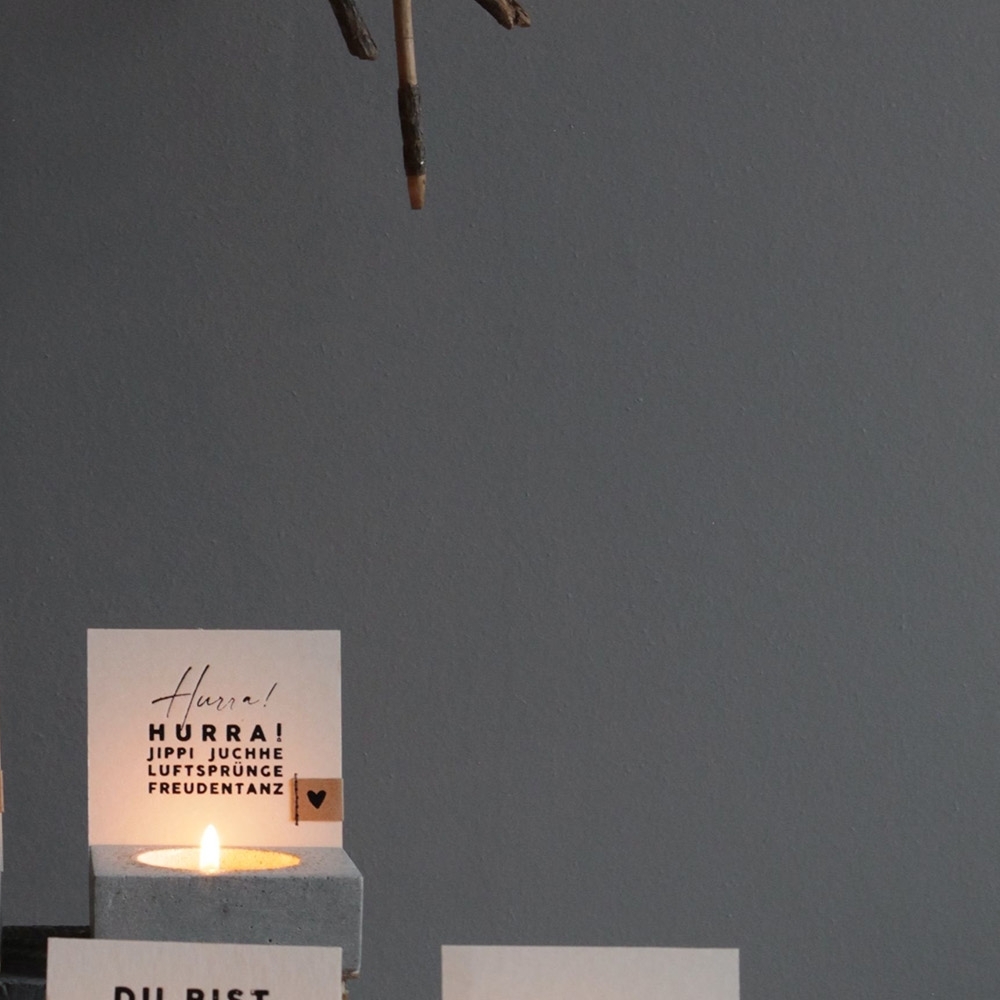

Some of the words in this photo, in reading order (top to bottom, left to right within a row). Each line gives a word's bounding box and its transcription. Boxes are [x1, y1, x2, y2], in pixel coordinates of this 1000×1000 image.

[151, 664, 278, 730] Hurra!
[148, 723, 283, 742] HURRA!
[146, 747, 194, 761] JIPPI
[208, 747, 284, 760] JUCHHE
[147, 761, 284, 777] LUFTSPRÜNGE
[148, 782, 284, 795] FREUDENTANZ
